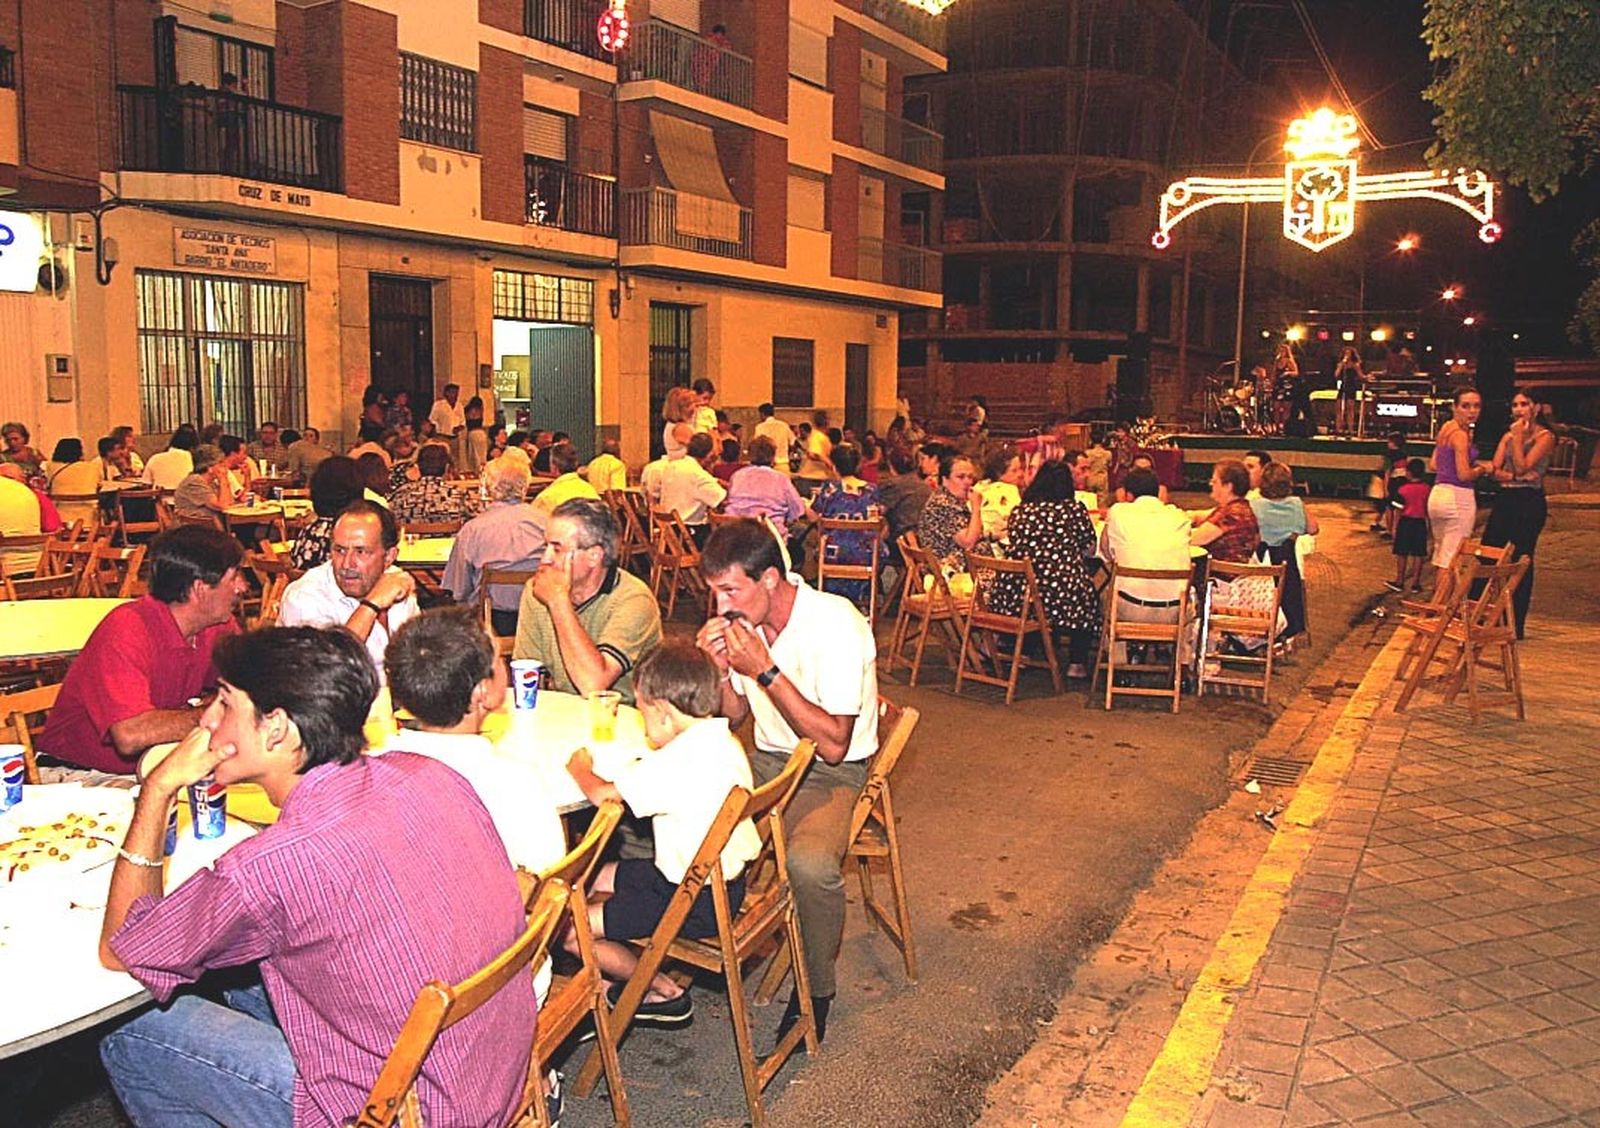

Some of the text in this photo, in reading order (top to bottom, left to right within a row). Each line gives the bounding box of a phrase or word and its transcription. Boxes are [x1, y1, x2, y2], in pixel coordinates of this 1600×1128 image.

[239, 184, 311, 207] CRUZ DE MAYO
[226, 233, 238, 246] DE
[240, 236, 272, 249] VECINOS
